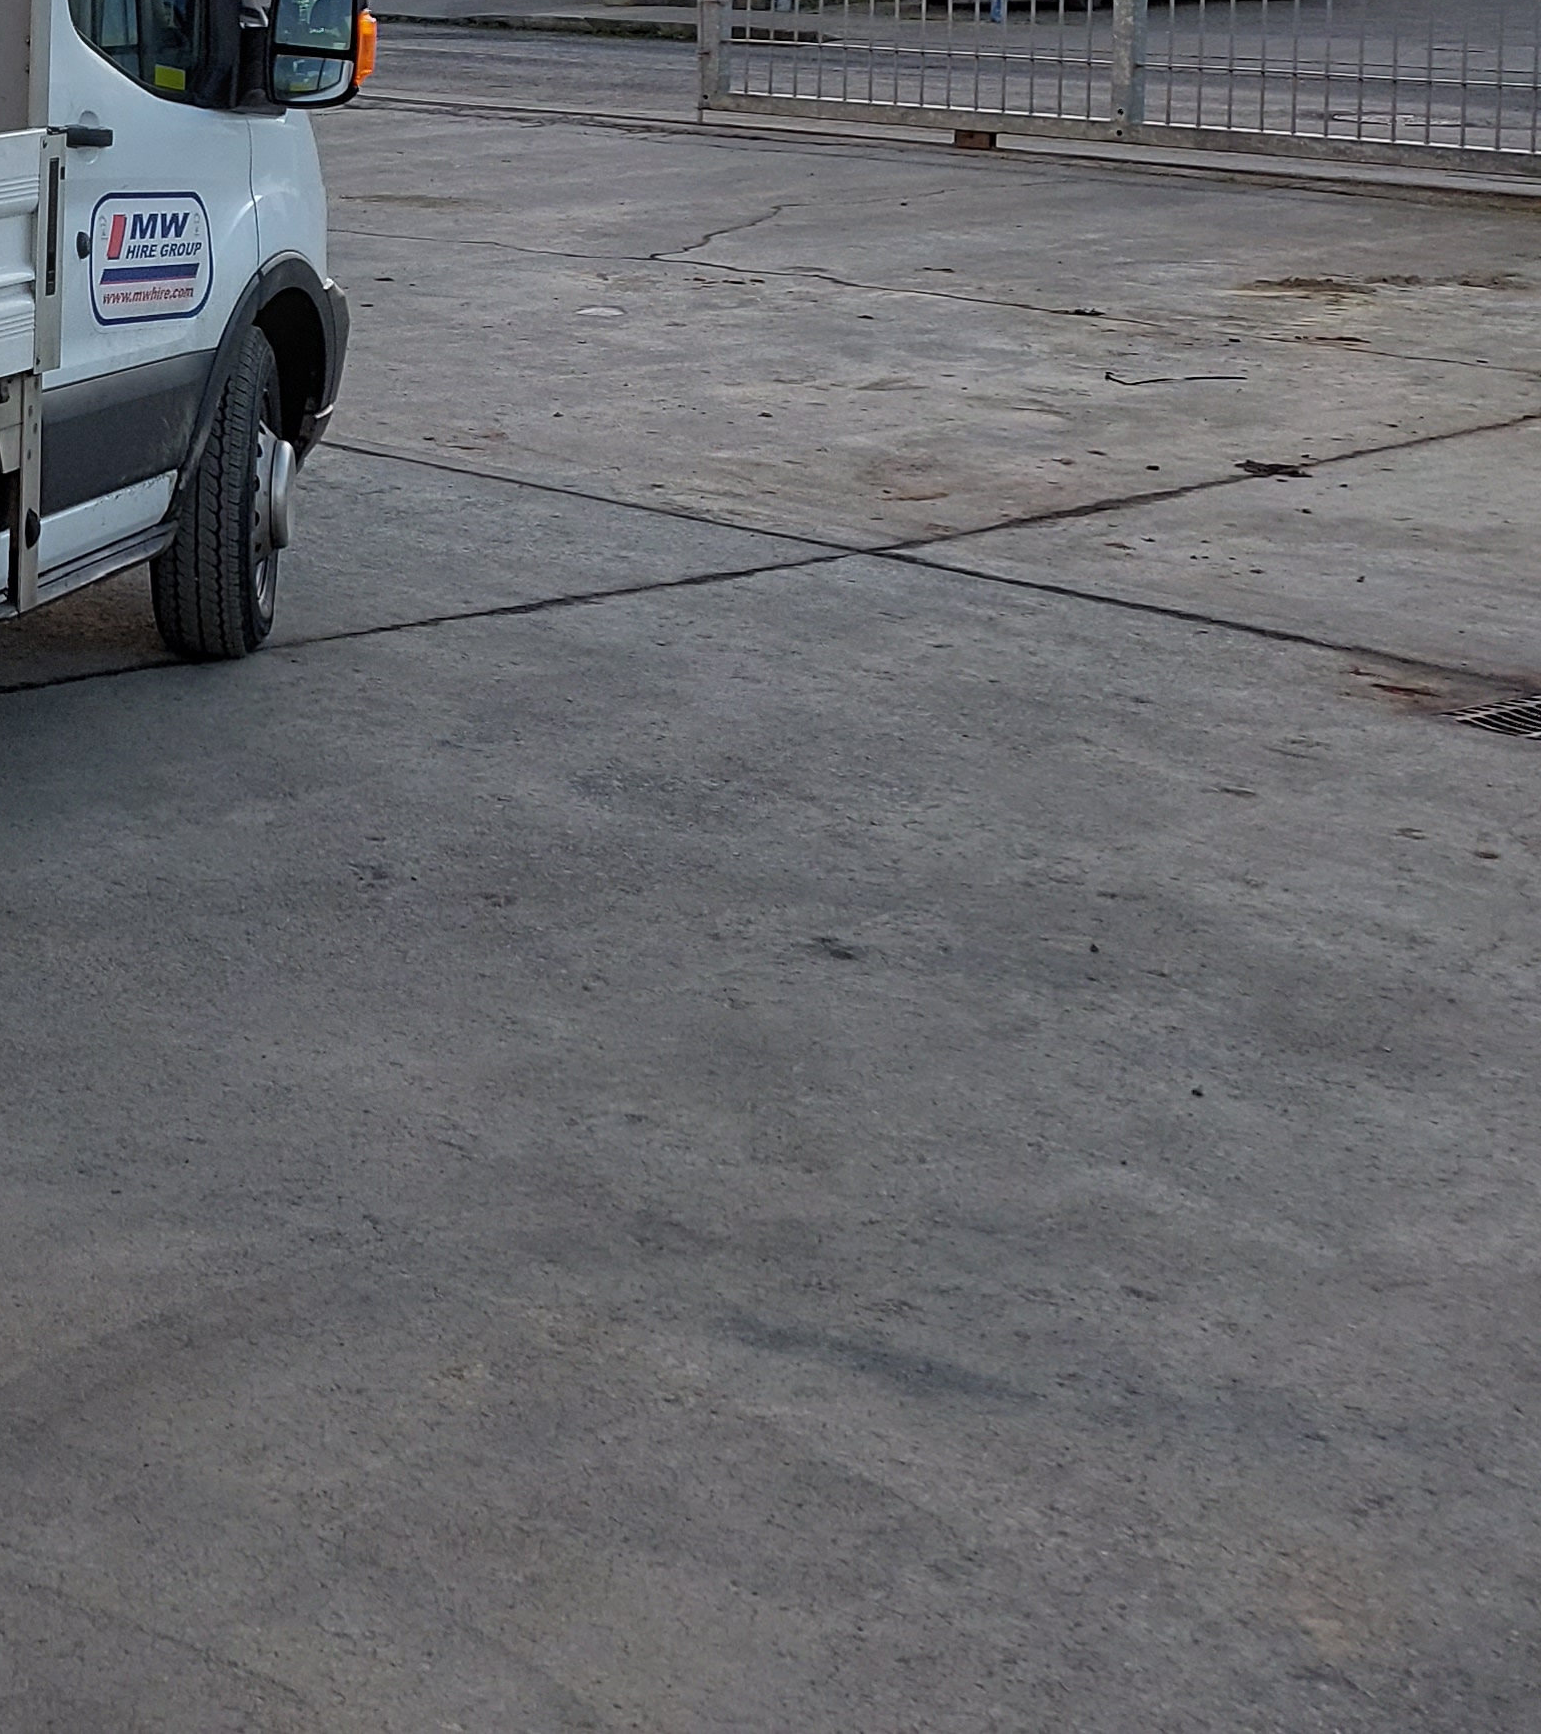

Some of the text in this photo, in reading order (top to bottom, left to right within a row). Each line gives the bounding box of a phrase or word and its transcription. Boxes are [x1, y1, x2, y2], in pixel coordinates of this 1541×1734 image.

[129, 212, 191, 240] MW
[125, 242, 202, 260] HIRE GROUP
[102, 286, 194, 305] www.mwhire.com
